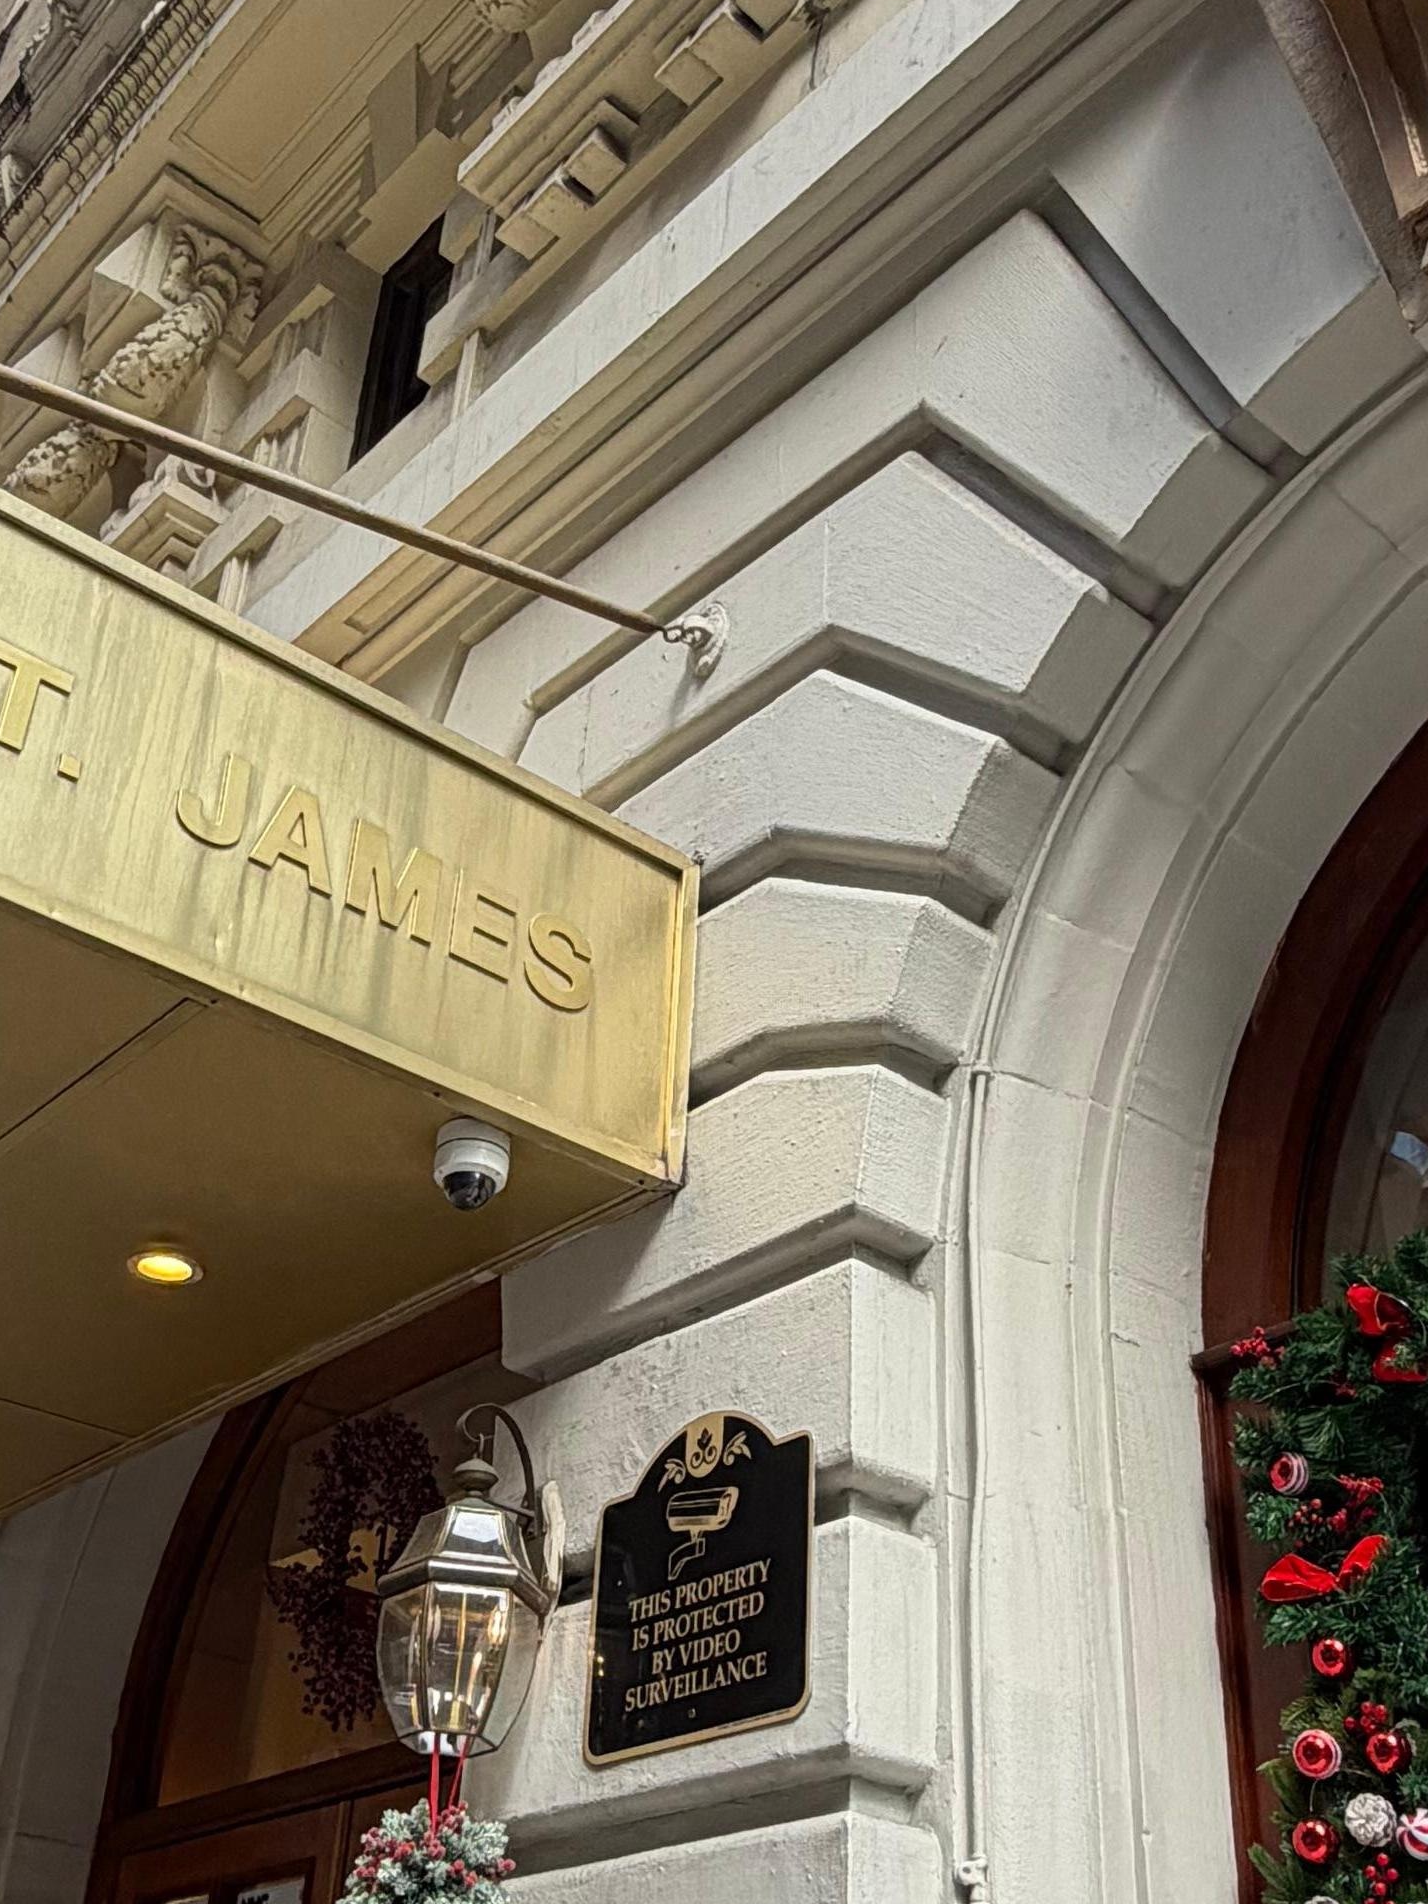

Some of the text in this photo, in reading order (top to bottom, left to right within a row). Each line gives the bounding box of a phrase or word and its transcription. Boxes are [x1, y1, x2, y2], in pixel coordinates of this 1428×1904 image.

[175, 752, 594, 1013] JAMES
[629, 1558, 771, 1623] THIS PROPERTY
[632, 1592, 764, 1651] IS PROTECTED
[652, 1629, 740, 1675] BY VIDEO
[624, 1651, 768, 1712] SURVEILLANCE
